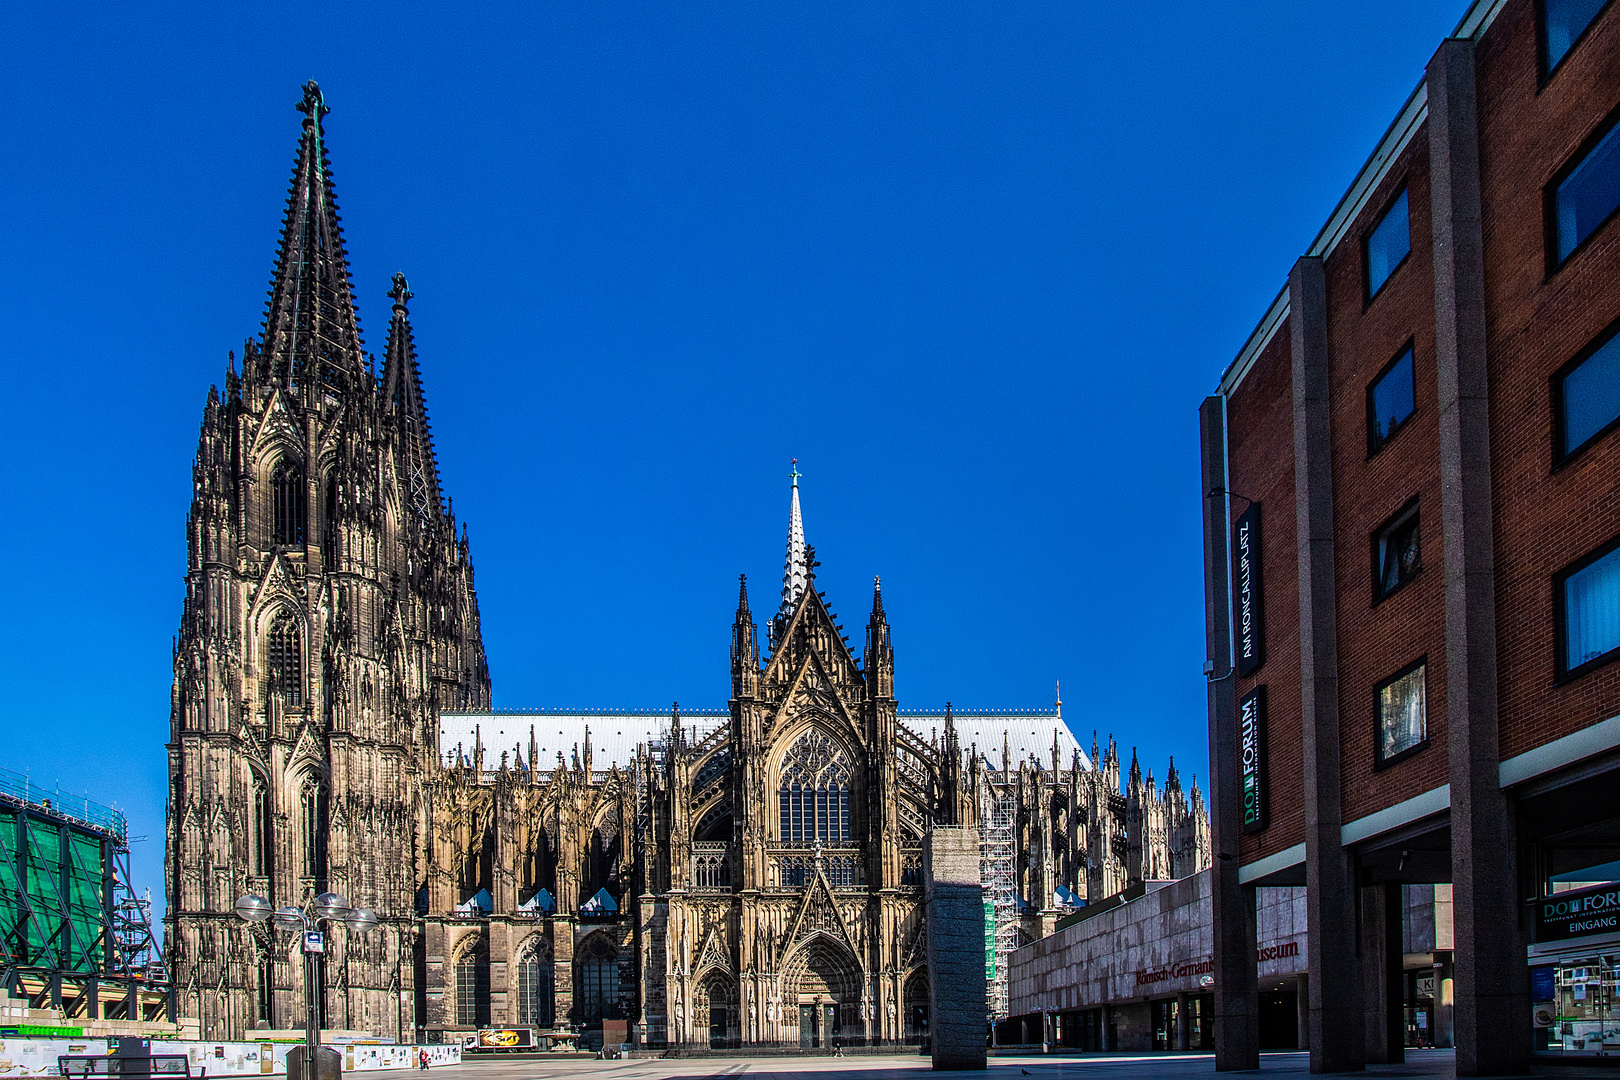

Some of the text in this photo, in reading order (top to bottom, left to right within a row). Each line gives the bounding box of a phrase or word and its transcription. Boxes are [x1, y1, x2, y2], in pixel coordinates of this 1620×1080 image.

[1240, 521, 1252, 658] AM RONCALLIPLATZ
[1544, 891, 1620, 917] DOMFOR
[1569, 916, 1617, 932] EINGANG
[1136, 941, 1300, 986] Römisch-Germanis useum
